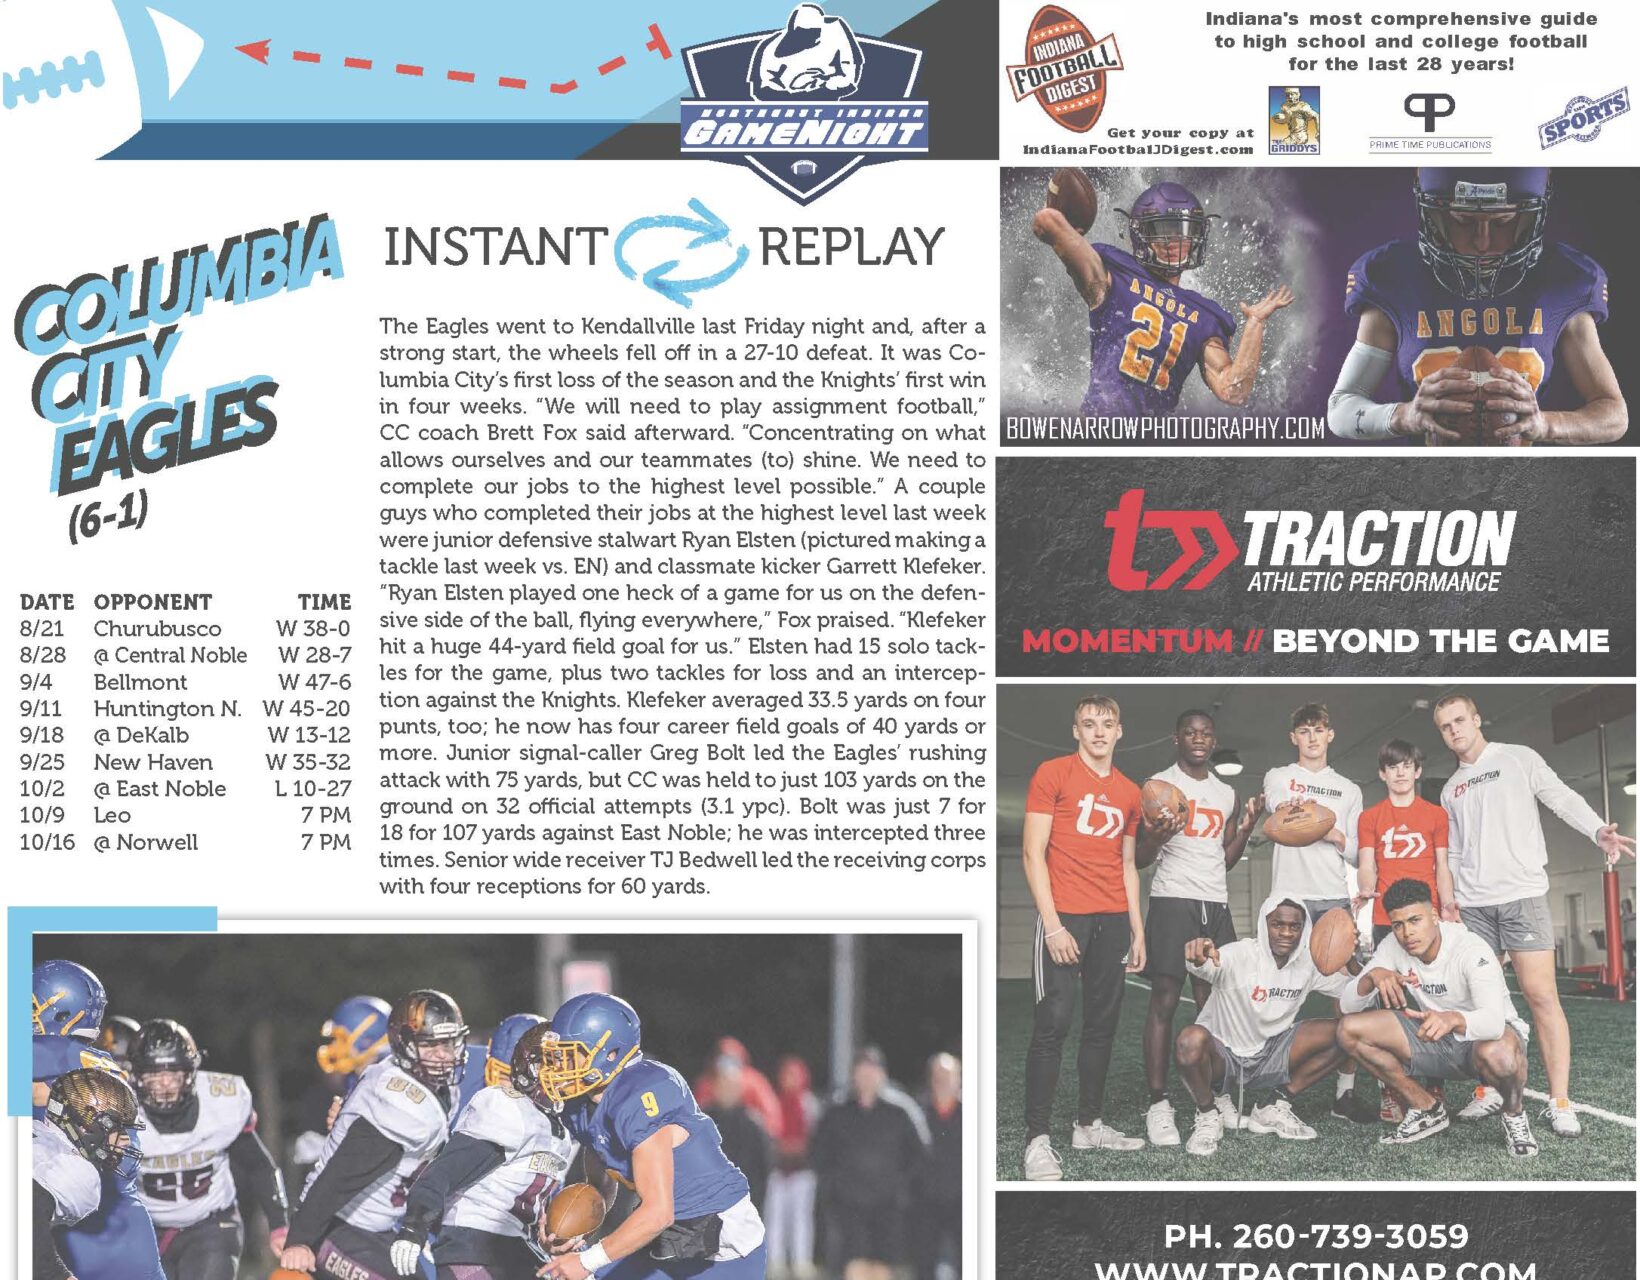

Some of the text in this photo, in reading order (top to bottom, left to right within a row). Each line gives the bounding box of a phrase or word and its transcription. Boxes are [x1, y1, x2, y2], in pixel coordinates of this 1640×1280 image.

[1206, 12, 1598, 30] Indiana's most comprehensive guide
[1033, 33, 1085, 62] INDIANA
[1214, 35, 1588, 52] to high school and college football
[1014, 44, 1118, 95] FOOTBALL
[1288, 57, 1514, 75] for the last 28 years!
[1045, 74, 1097, 104] DIGEST
[1544, 93, 1626, 143] SPORTS
[1107, 127, 1255, 140] Get your copy at
[1369, 140, 1492, 149] PRIME TIME PUBLICATIONS
[1271, 144, 1317, 152] GRIDDYS
[386, 226, 946, 267] INSTANT REPLAY
[14, 213, 344, 355] COLUMBIA
[1130, 278, 1199, 323] ANGOLA
[379, 316, 987, 339] The Eagles went to Kendallville last Friday night and, after a
[1417, 307, 1543, 337] ANGOLA
[1119, 301, 1188, 391] 21
[31, 324, 183, 424] CITY
[50, 375, 279, 497] EAGLES
[69, 488, 148, 545] (6-1)
[1243, 510, 1517, 567] TRACTION
[1247, 571, 1501, 592] ATHLETIC PERFORMANCE
[20, 593, 352, 611] DATE OPPONENT TIME
[20, 619, 351, 638] 8/21 Churubusco W 38-0
[1022, 629, 1233, 653] MOMENTUM
[1273, 628, 1420, 653] BEYOND
[1428, 628, 1498, 653] THE
[1507, 628, 1610, 653] GAME
[20, 806, 352, 825] 10/9 Leo 7 PM
[641, 1092, 660, 1117] 9
[1164, 1223, 1469, 1249] PH. 260-739-3059
